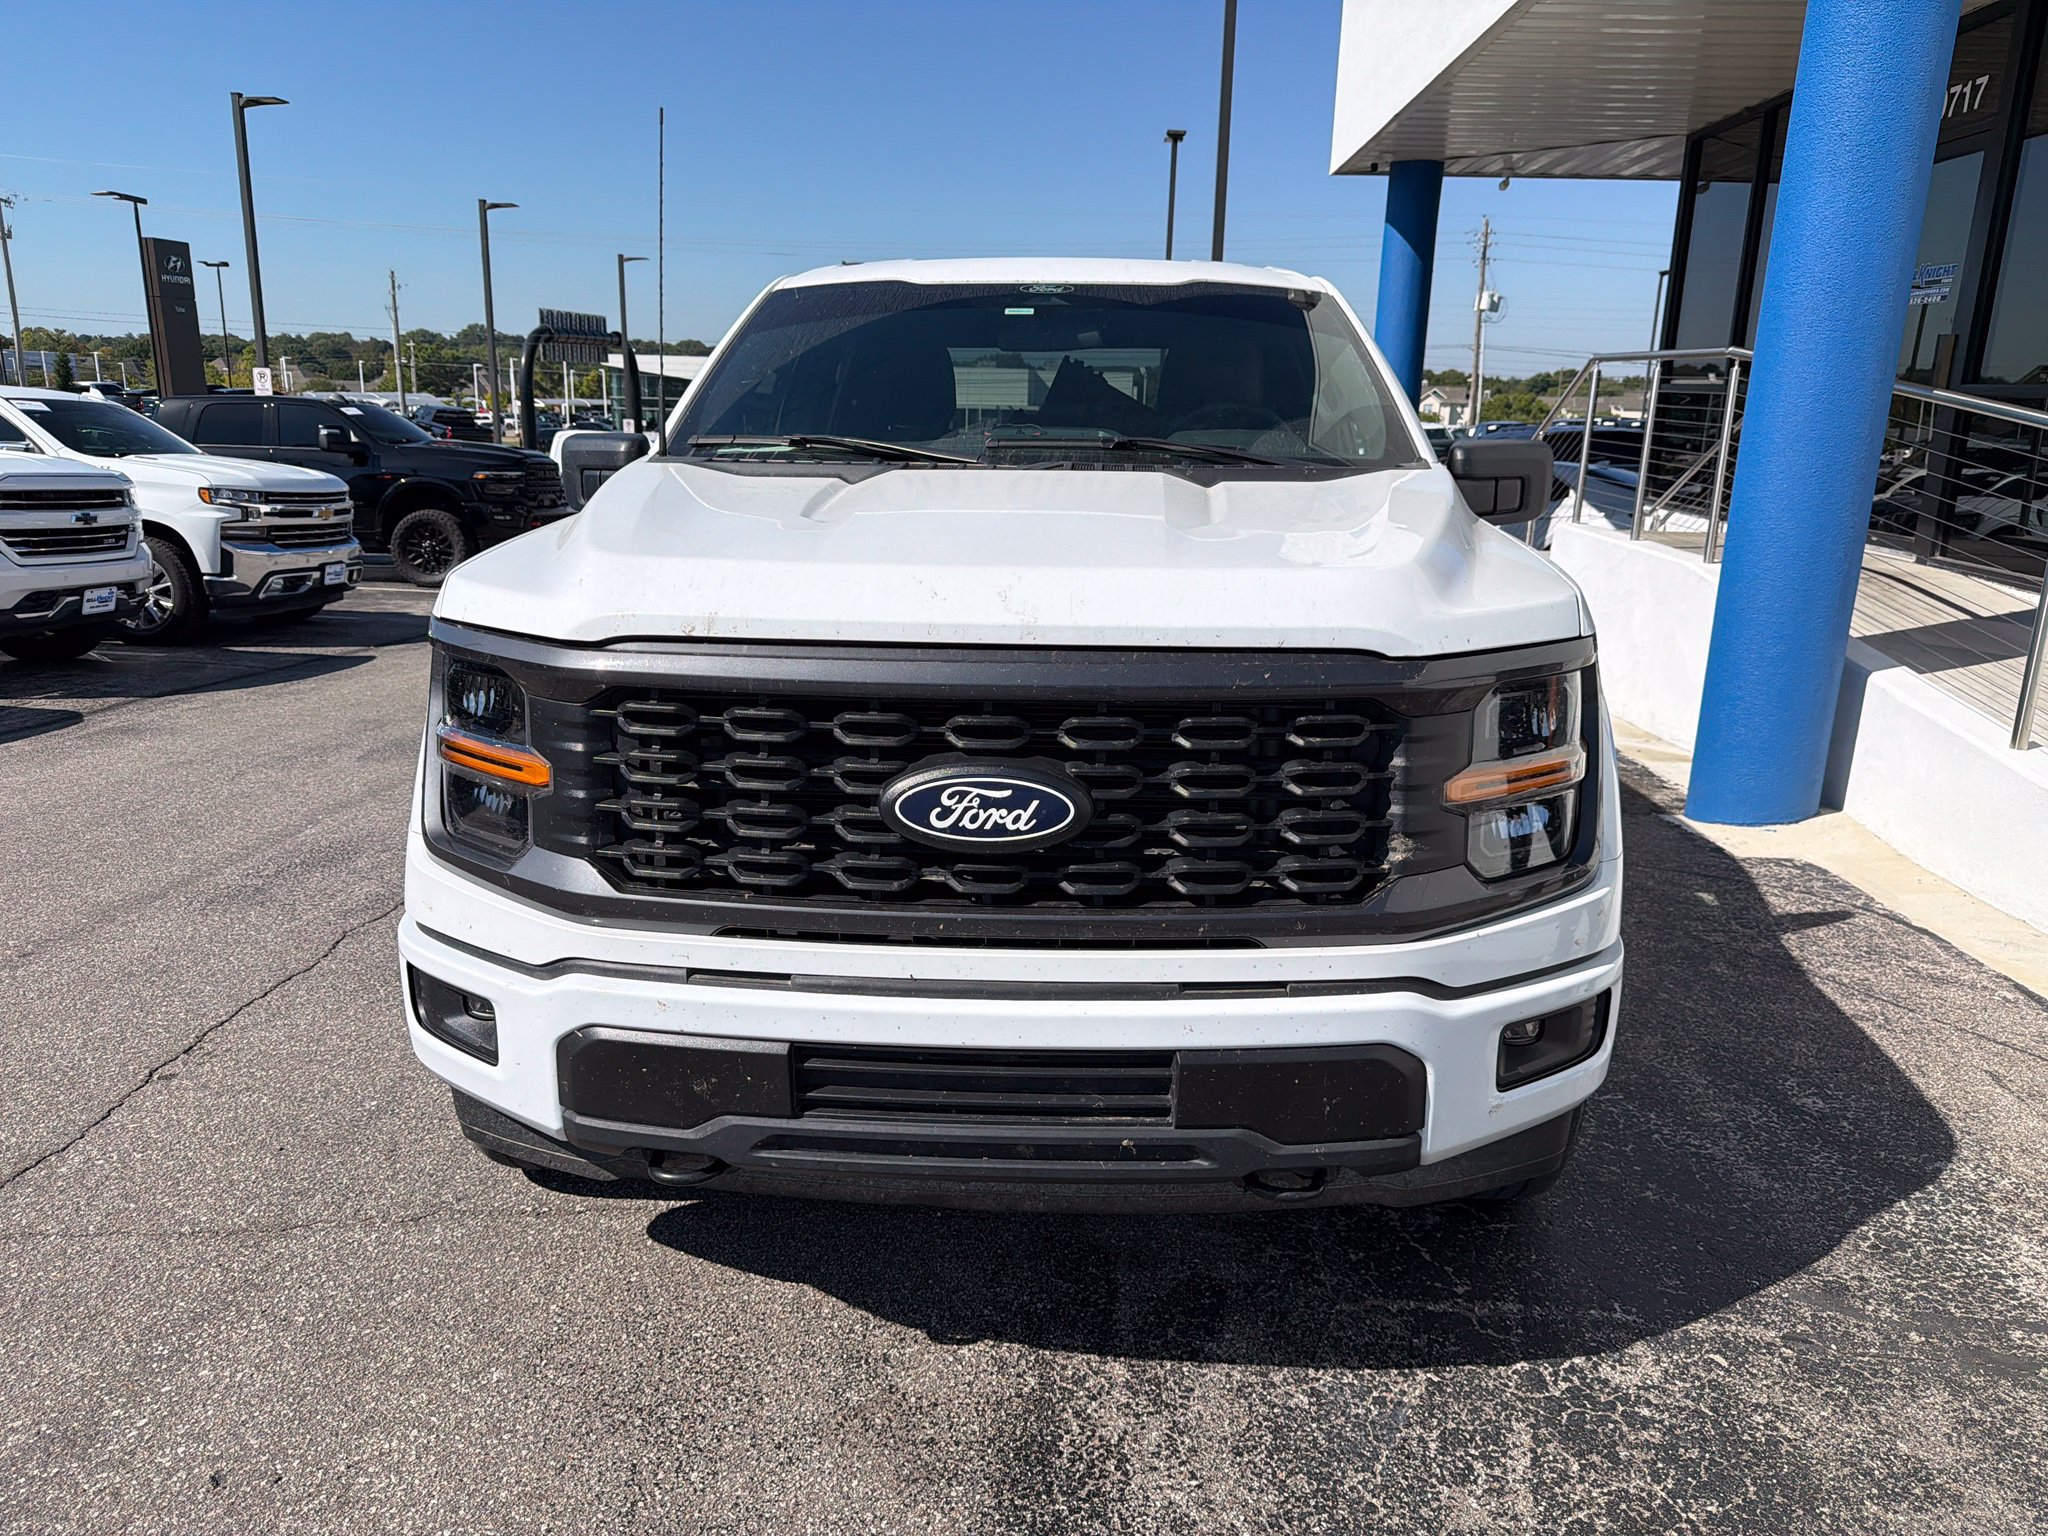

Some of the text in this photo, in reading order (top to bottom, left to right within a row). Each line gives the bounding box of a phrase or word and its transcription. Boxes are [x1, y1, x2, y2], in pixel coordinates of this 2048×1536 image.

[160, 274, 192, 285] HYUNDAI
[1028, 284, 1066, 293] Ford
[929, 786, 1041, 831] Ford
